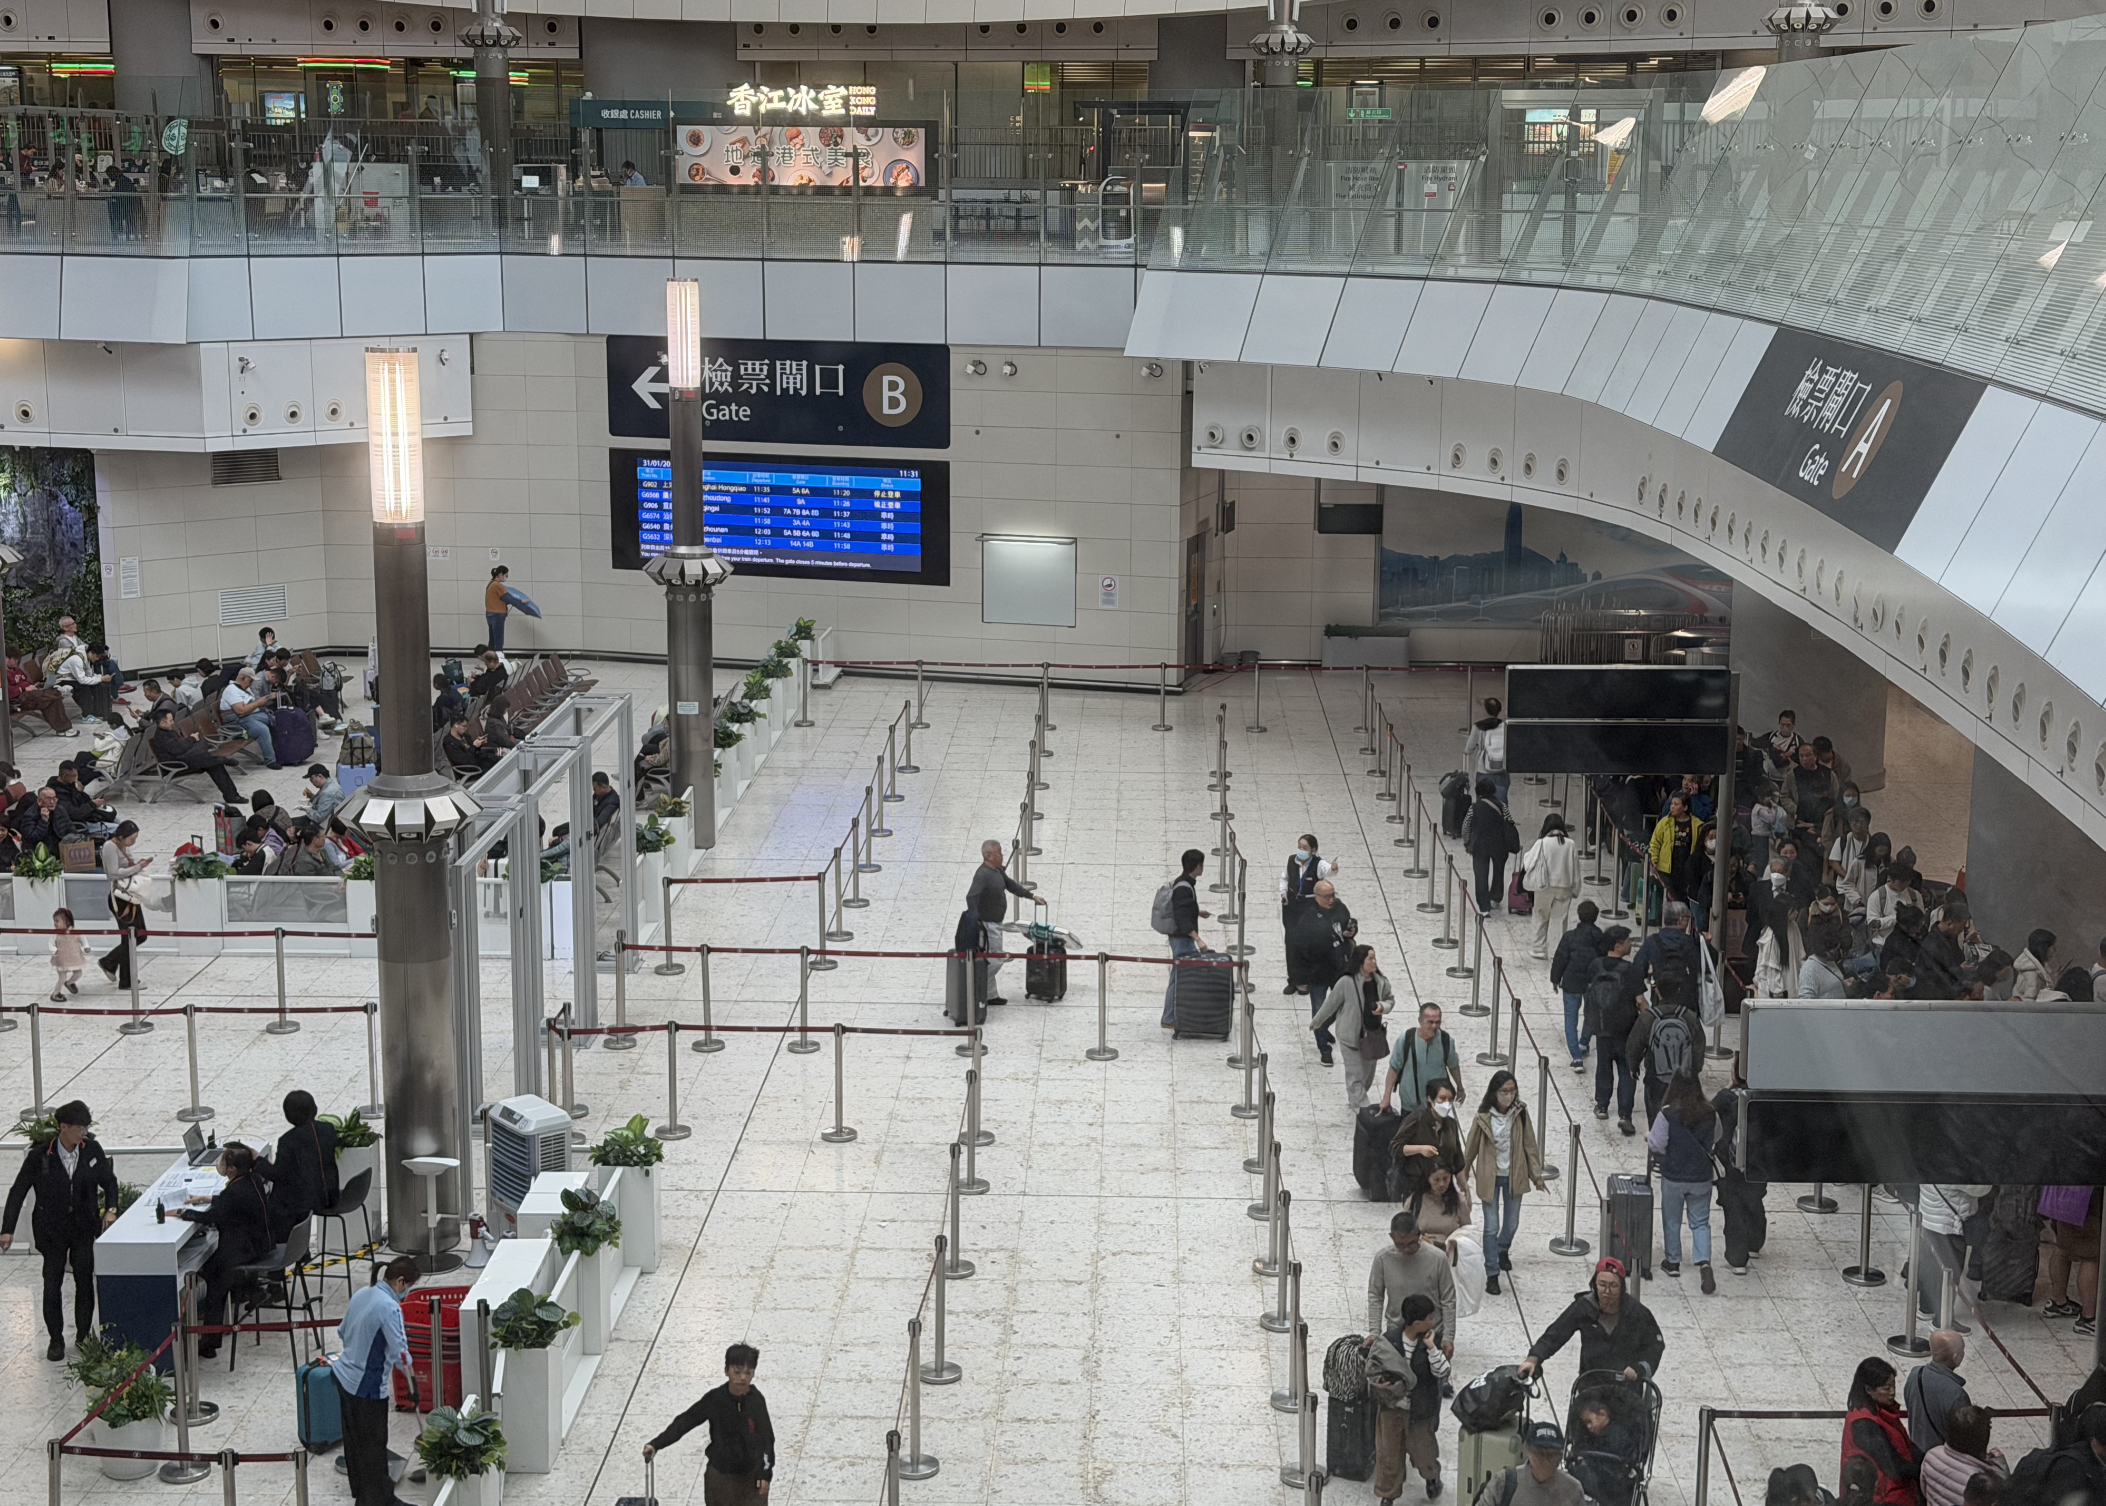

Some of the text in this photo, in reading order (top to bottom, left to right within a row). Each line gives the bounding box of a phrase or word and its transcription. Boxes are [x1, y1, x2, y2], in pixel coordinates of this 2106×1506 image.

[849, 86, 876, 95] HONG
[726, 82, 849, 116] 香江冰室
[849, 96, 876, 106] KONG
[630, 110, 662, 120] CASHIER
[849, 106, 876, 116] DAILY
[702, 356, 845, 397] 檢票閘口
[882, 375, 907, 414] B
[1784, 356, 1872, 438] 檢票閘口
[702, 400, 751, 422] Gate
[1840, 398, 1892, 478] A
[642, 460, 671, 468] 31/01/20
[1798, 443, 1830, 486] Gate
[900, 470, 919, 478] 11:31
[718, 484, 747, 492] Hongqiao
[703, 494, 731, 503] zhoudong
